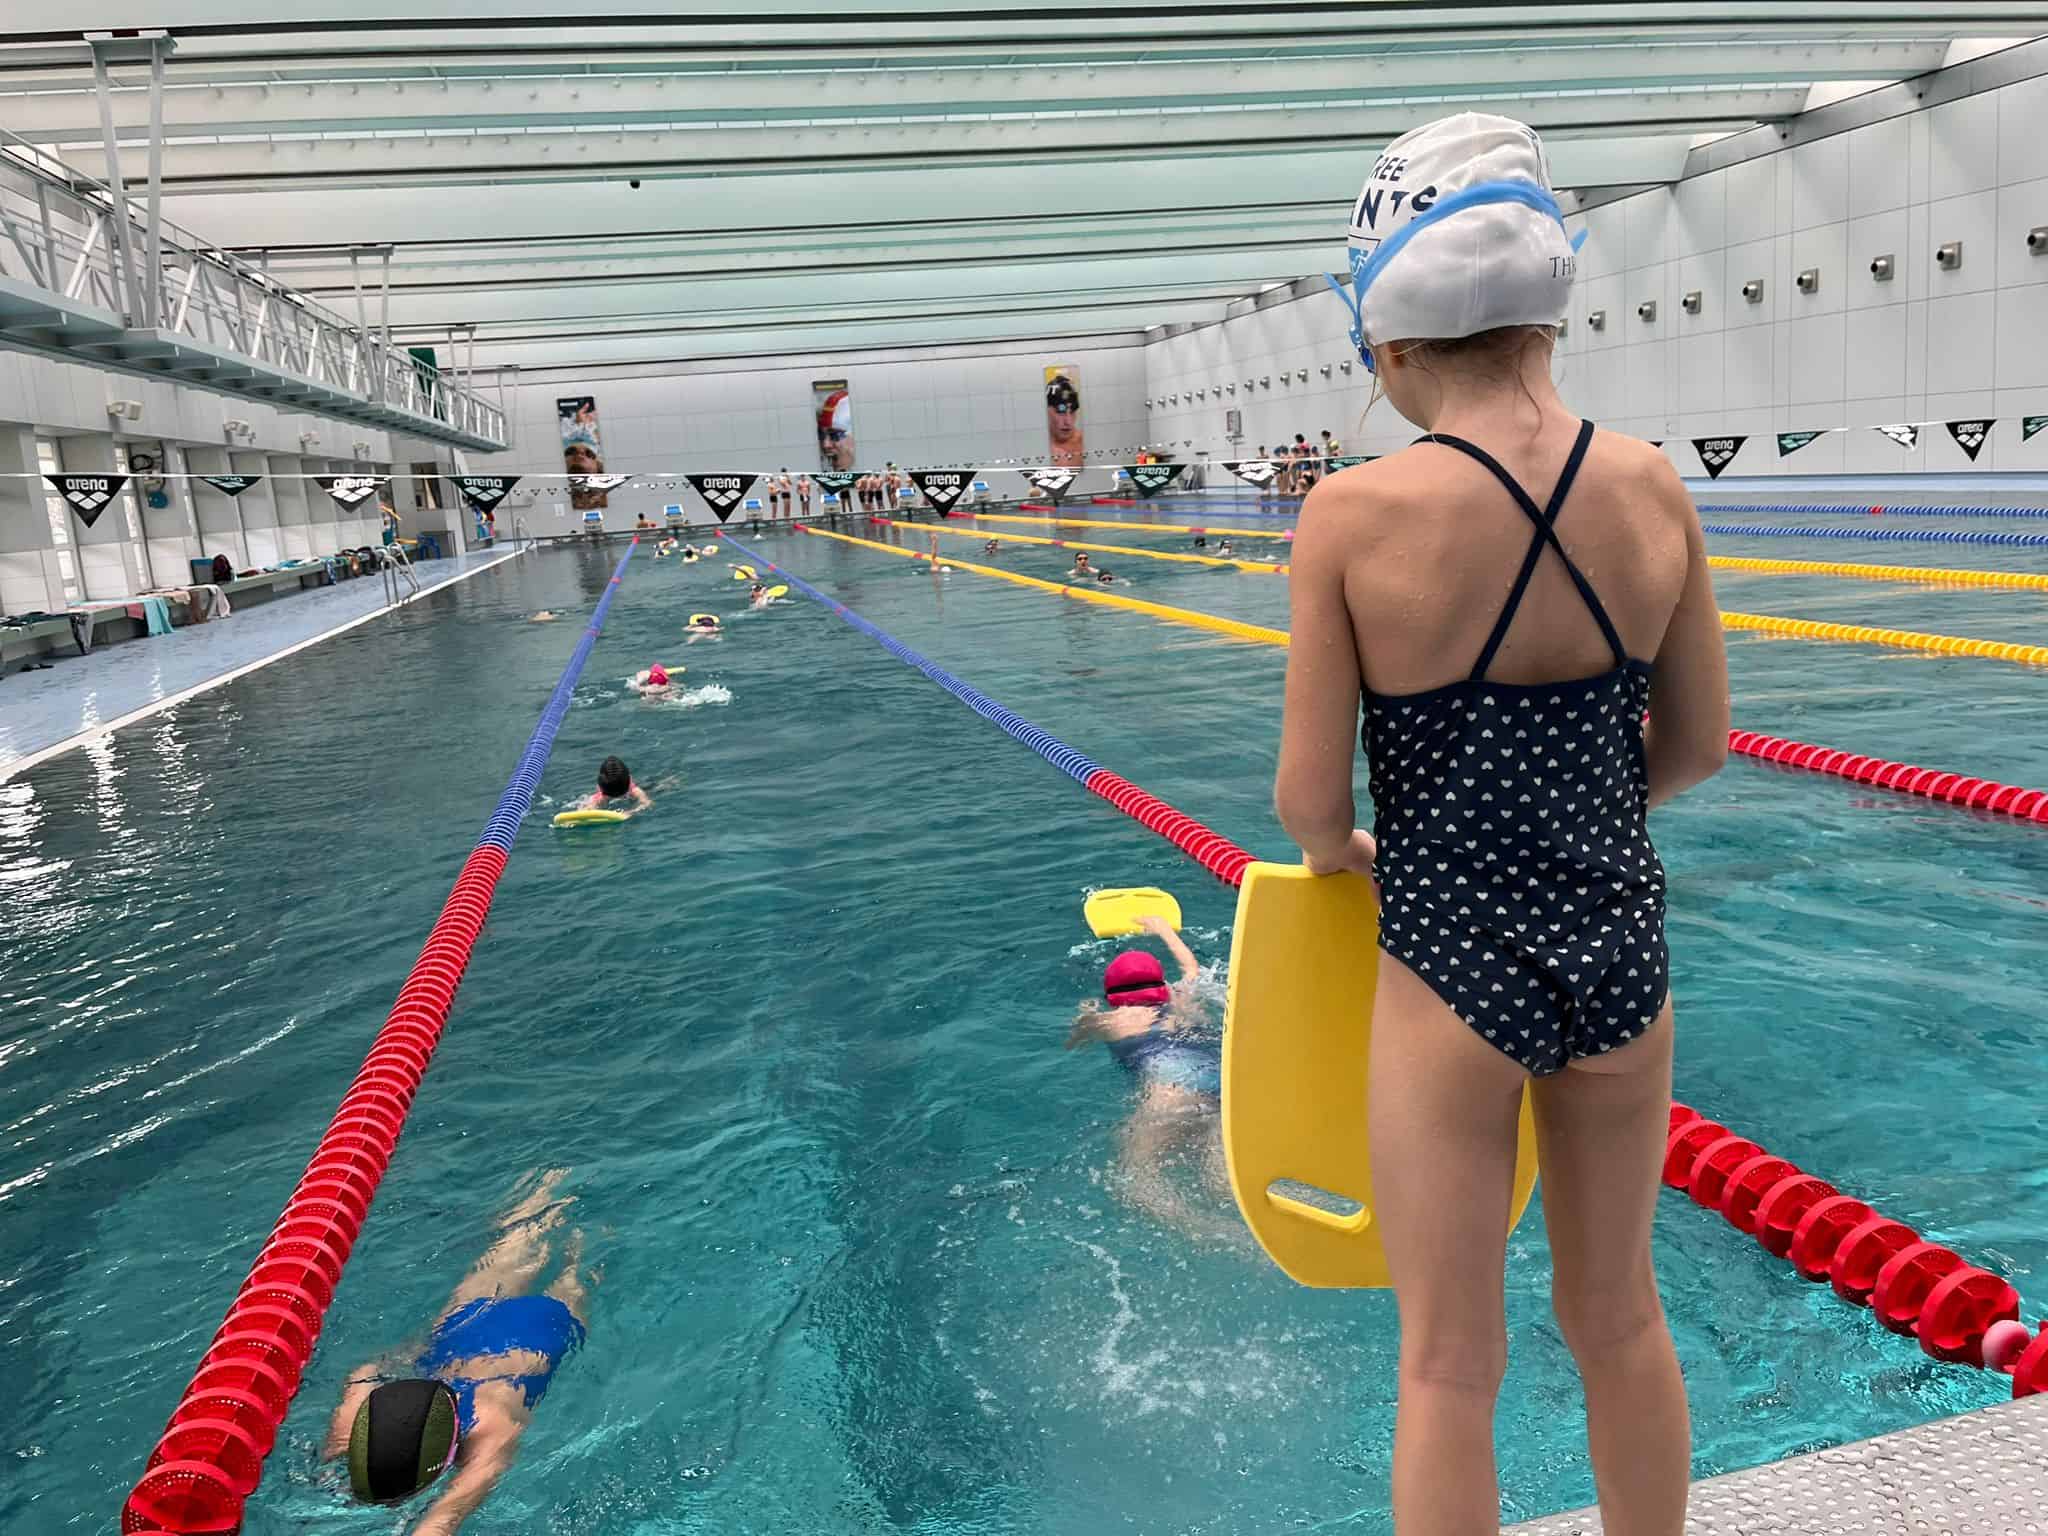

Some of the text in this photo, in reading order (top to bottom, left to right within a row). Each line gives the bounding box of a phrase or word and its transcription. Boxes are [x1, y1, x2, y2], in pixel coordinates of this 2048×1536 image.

[1350, 185, 1438, 230] NTS
[1957, 422, 1984, 433] arena
[1703, 440, 1734, 451] arena
[1136, 467, 1170, 476] arena
[66, 477, 108, 492] arena
[462, 477, 503, 488] arena
[703, 477, 741, 489] arena
[924, 474, 960, 486] arena
